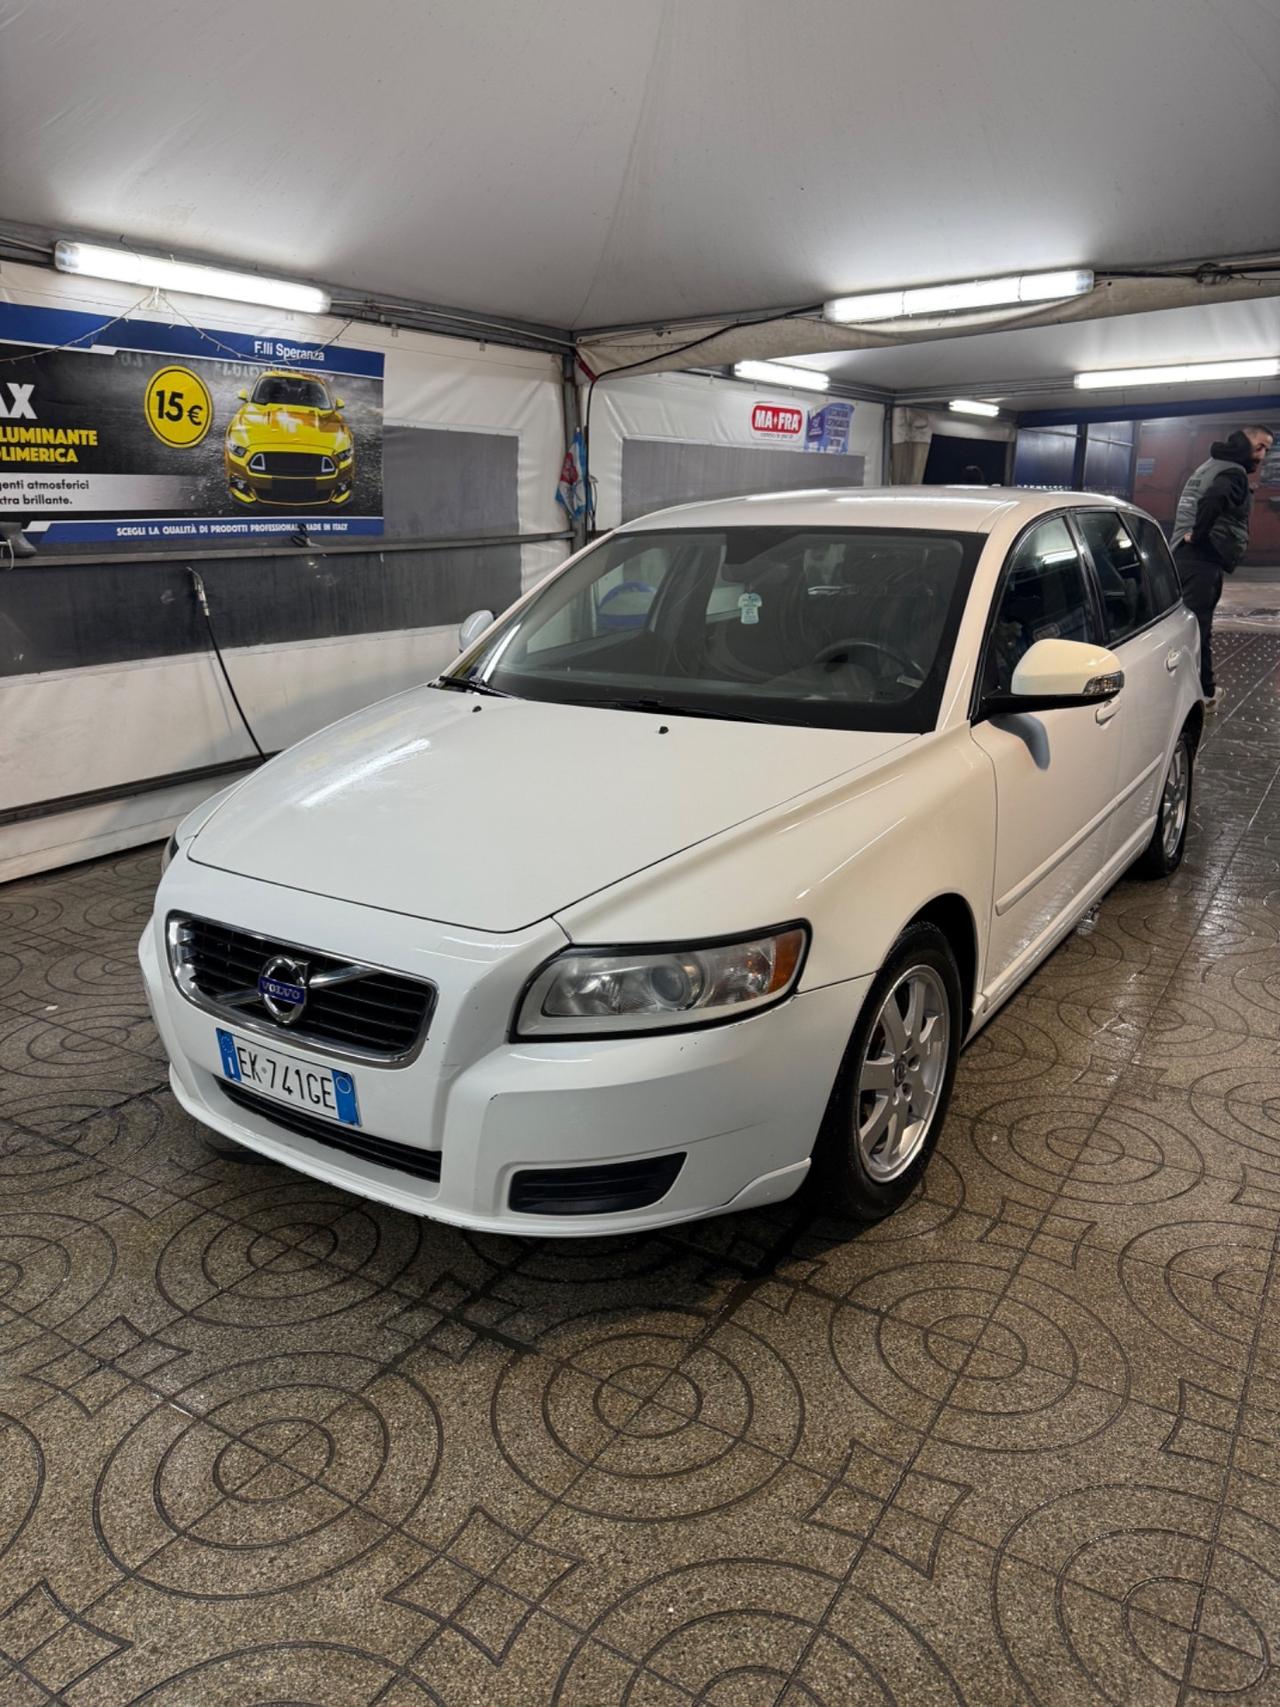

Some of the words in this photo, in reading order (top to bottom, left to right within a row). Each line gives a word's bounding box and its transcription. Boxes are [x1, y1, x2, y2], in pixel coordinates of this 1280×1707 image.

[275, 343, 325, 361] Speranza
[0, 446, 79, 462] LIMERICA
[27, 479, 89, 490] atmosferici
[23, 494, 73, 505] brillante.
[116, 527, 146, 536] SCEGLI
[148, 526, 160, 535] LA
[162, 524, 197, 535] QUALITÀ
[199, 525, 208, 533] DI
[210, 524, 248, 533] PRODOTTI
[250, 523, 301, 532] PROFESSIONAL
[262, 980, 301, 1000] VOLVO
